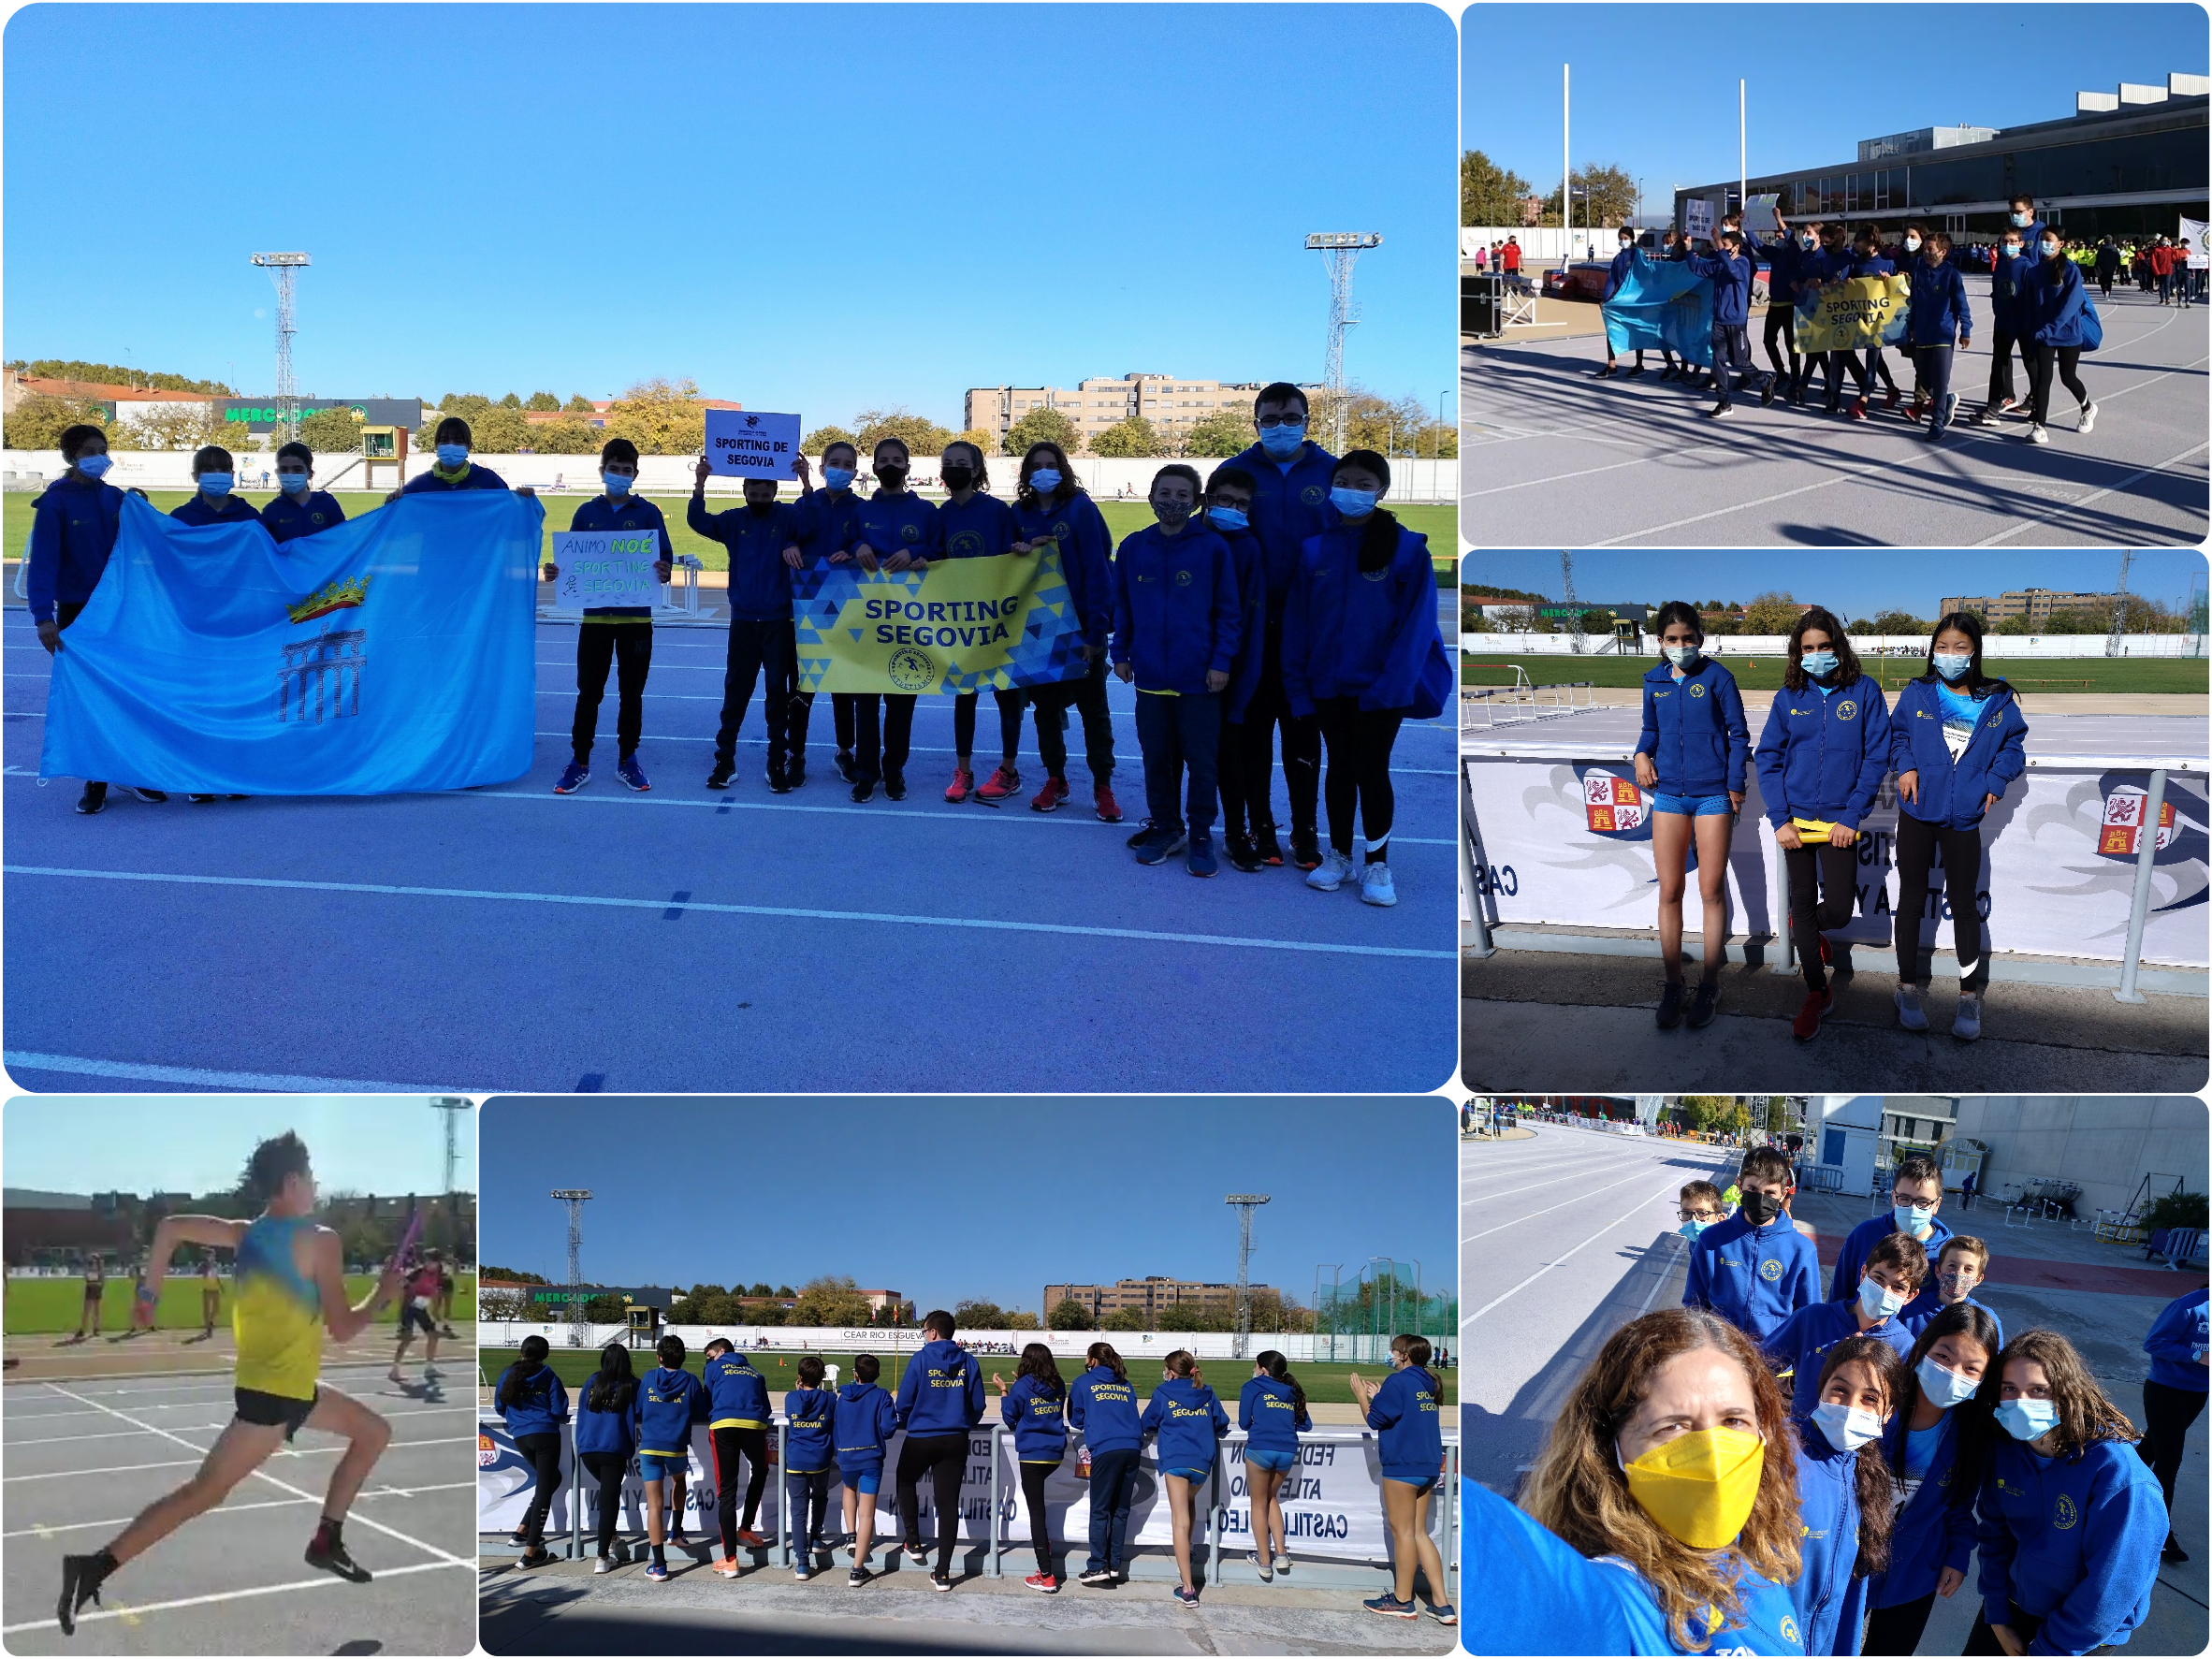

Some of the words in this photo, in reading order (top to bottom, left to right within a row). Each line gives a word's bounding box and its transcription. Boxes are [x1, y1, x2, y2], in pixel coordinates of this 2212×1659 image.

[1826, 297, 1890, 313] SPORTING
[1831, 311, 1885, 326] SEGOVIA
[225, 407, 331, 423] MERCADO
[716, 437, 770, 452] SPORTING
[773, 441, 789, 453] DE
[727, 453, 775, 468] SEGOVIA
[611, 531, 654, 555] NOÉ
[573, 560, 649, 575] SPORTING
[866, 596, 1019, 622] SPORTING
[1540, 608, 1598, 618] MERCADO
[877, 623, 1010, 648] SEGOVIA
[891, 649, 912, 670] SPORTING
[913, 650, 932, 670] SEGOVIA
[892, 675, 933, 691] ATLETISMO
[534, 1292, 610, 1303] MERCADO
[844, 1331, 867, 1339] CEAR
[724, 1369, 758, 1379] SEGOVIA
[930, 1378, 965, 1388] SEGOVIA
[1090, 1385, 1131, 1393] SPORTING
[1095, 1392, 1128, 1402] SEGOVIA
